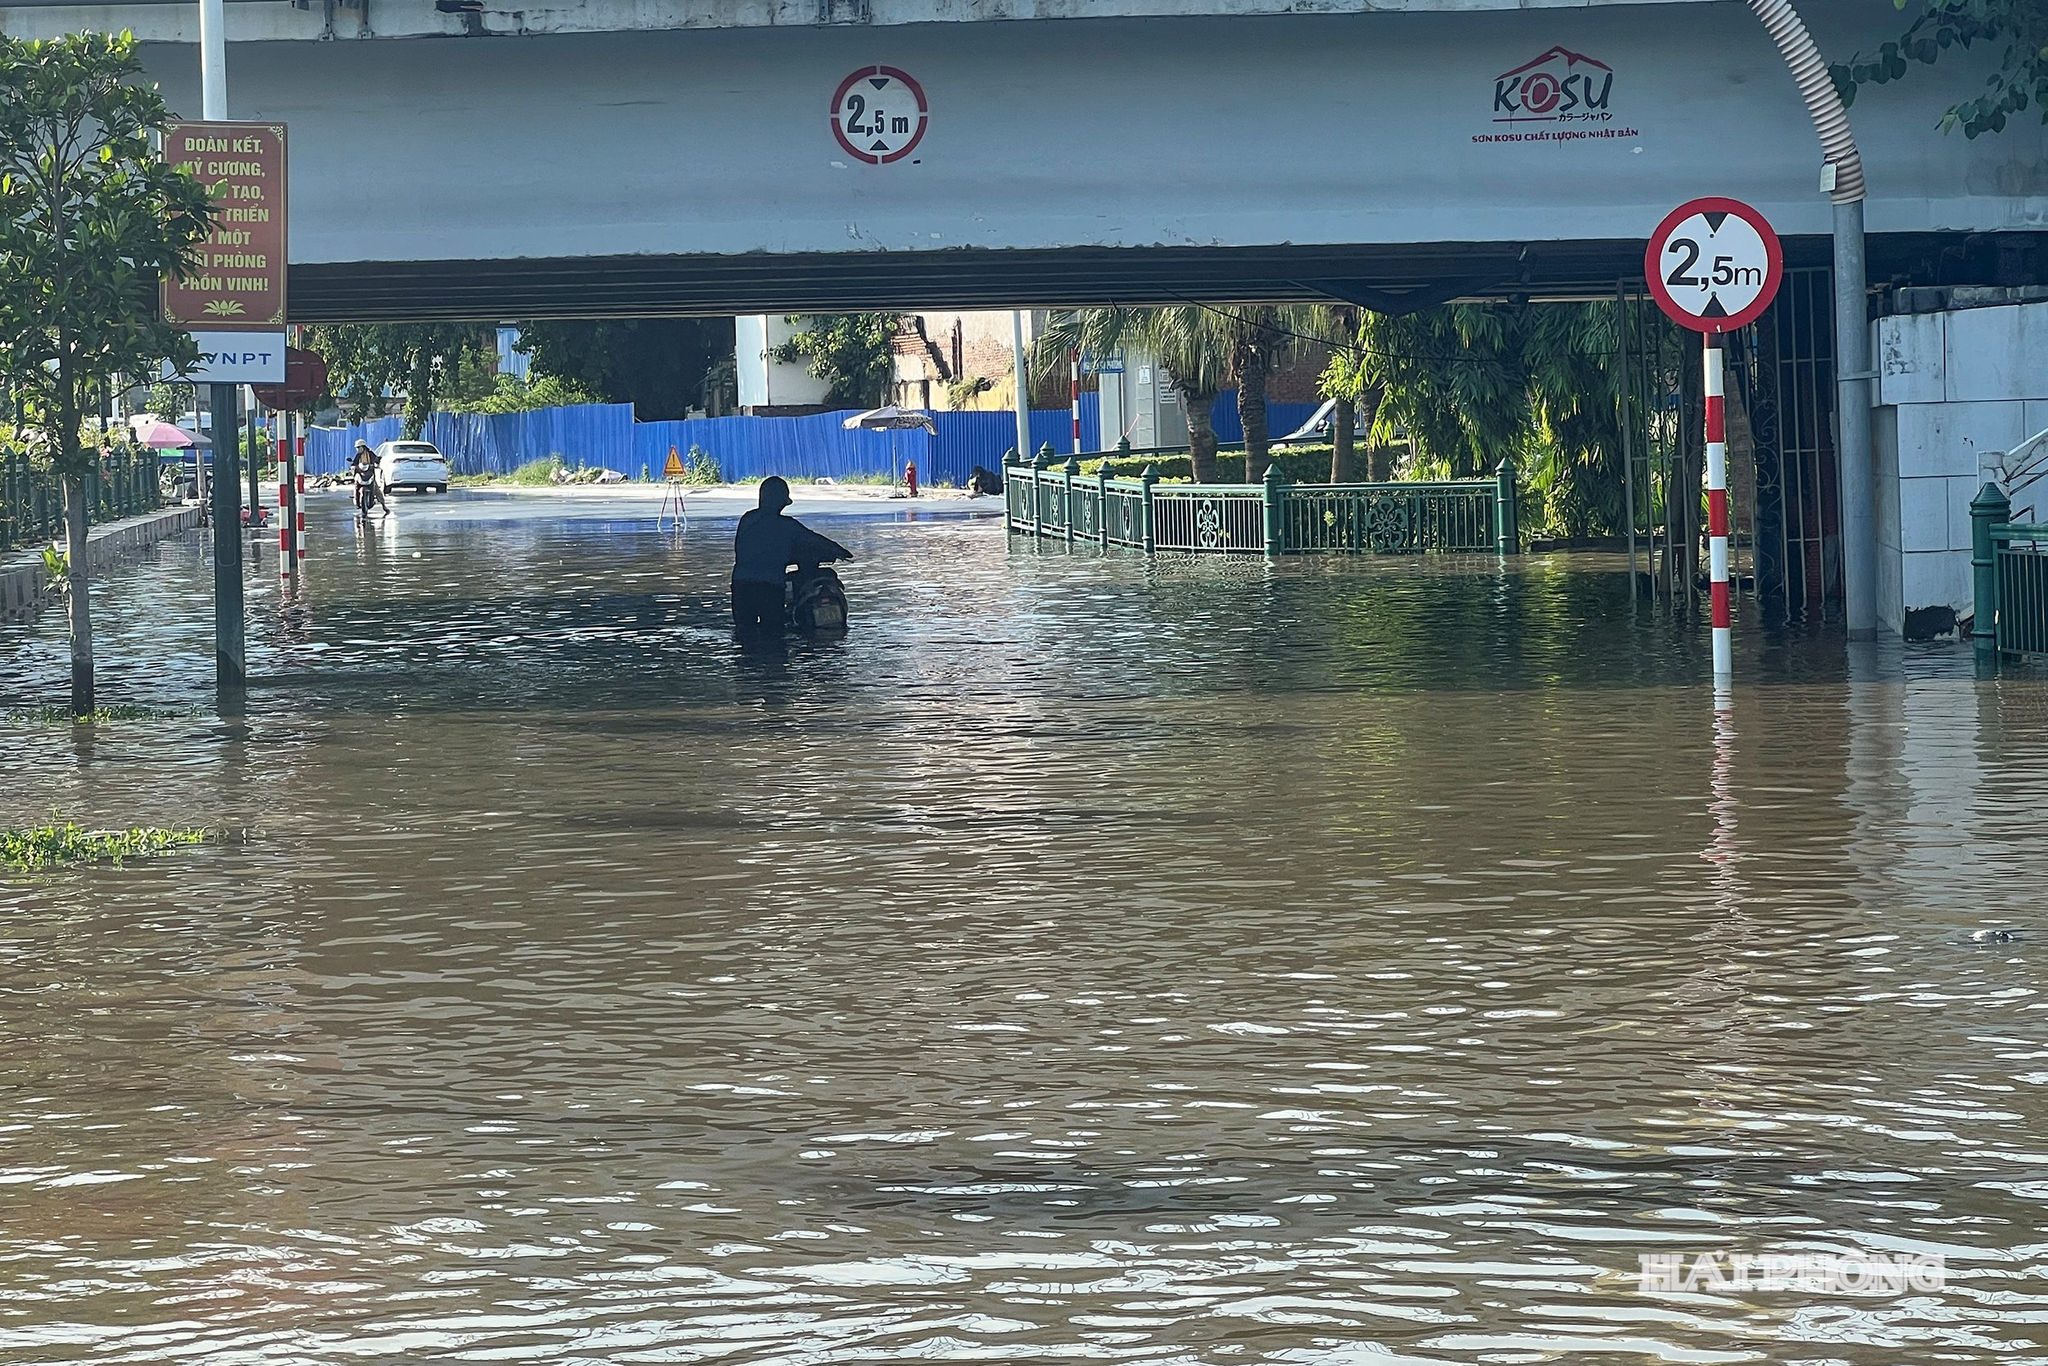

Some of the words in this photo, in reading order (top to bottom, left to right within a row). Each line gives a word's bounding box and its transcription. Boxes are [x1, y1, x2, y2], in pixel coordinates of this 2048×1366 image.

[1494, 72, 1613, 113] KOSU
[847, 94, 885, 138] 2,5
[891, 116, 909, 134] m
[1472, 135, 1492, 143] SƠN
[1524, 130, 1550, 141] CHẤT
[1552, 131, 1586, 141] LƯỢNG
[1588, 129, 1615, 139] NHẬT
[1617, 127, 1639, 137] BẢN
[185, 135, 228, 153] ĐOÀN
[232, 135, 264, 154] KẾT,
[207, 161, 266, 177] CƯƠNG,
[231, 185, 265, 202] TẠO,
[226, 202, 270, 222] TRIỂN
[217, 228, 252, 248] MỘT
[213, 250, 267, 268] PHÒNG
[1666, 238, 1762, 292] 2,5m
[226, 277, 269, 291] VINH!
[206, 352, 272, 366] VNPT
